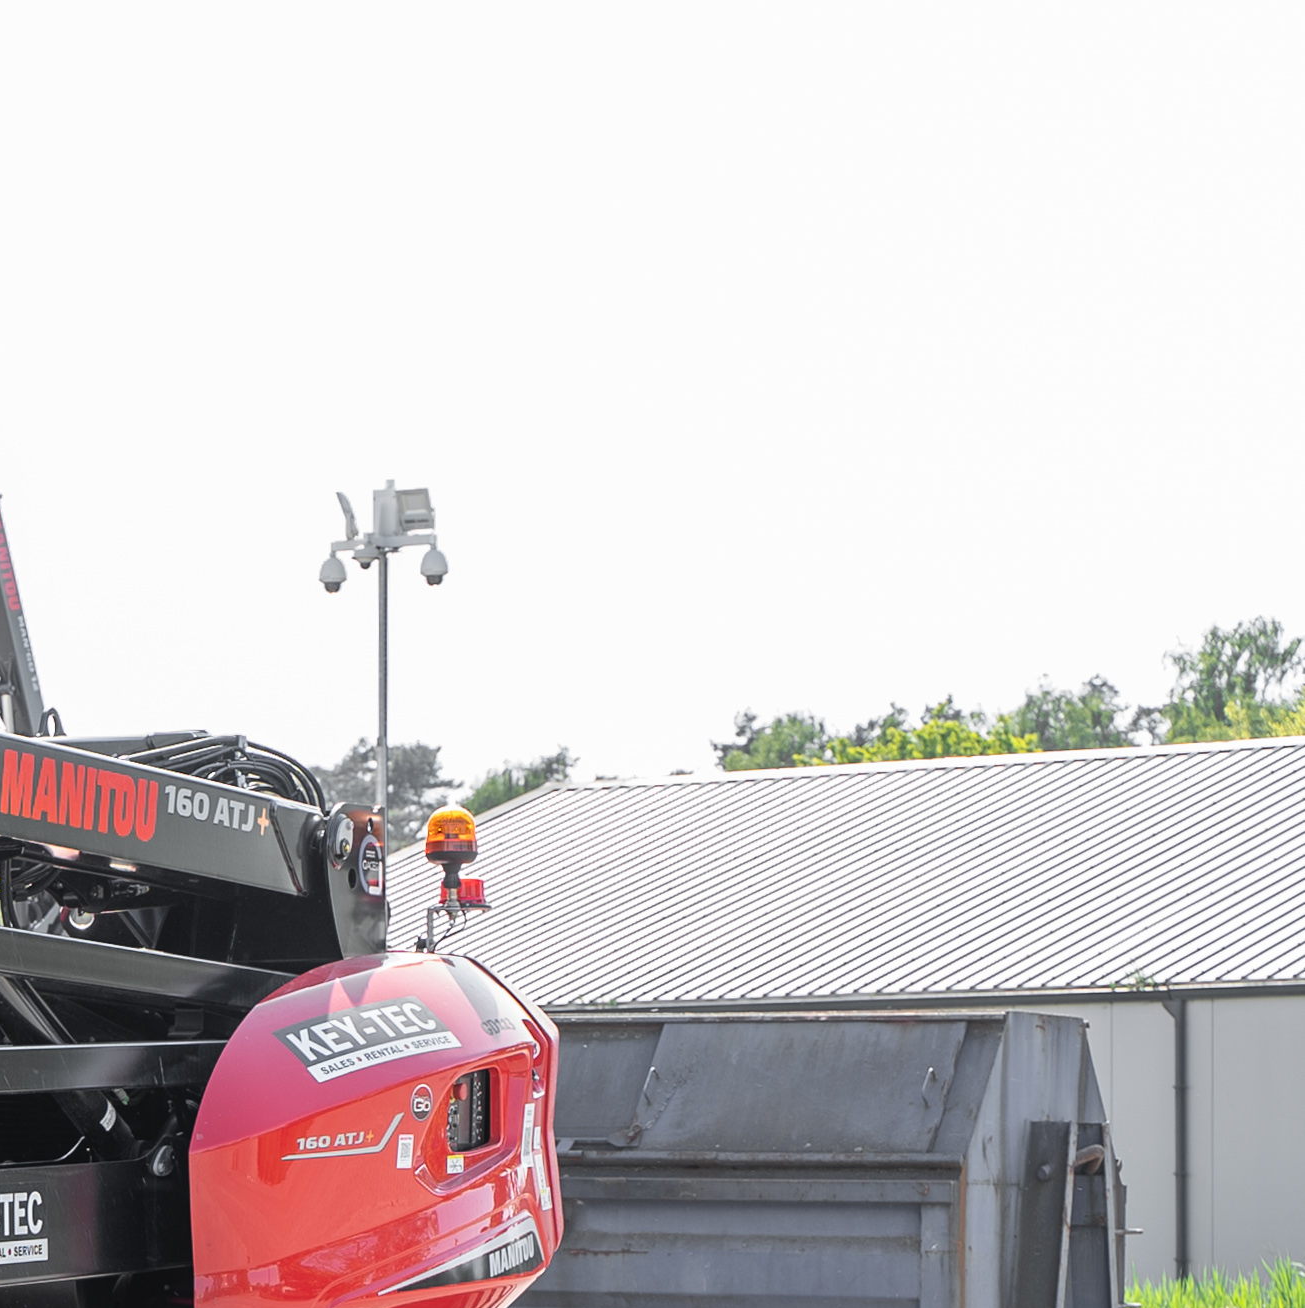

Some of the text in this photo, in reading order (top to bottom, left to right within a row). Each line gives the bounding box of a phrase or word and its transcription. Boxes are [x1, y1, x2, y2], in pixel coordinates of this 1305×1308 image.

[0, 749, 159, 842] MANITOU
[164, 784, 210, 822] 160
[286, 1002, 437, 1062] KEY-TEC
[320, 1034, 453, 1076] SALES RENTAL SERVICE
[296, 1135, 331, 1151] 160
[13, 1244, 43, 1257] SERVICE
[489, 1233, 536, 1278] MANITOU
